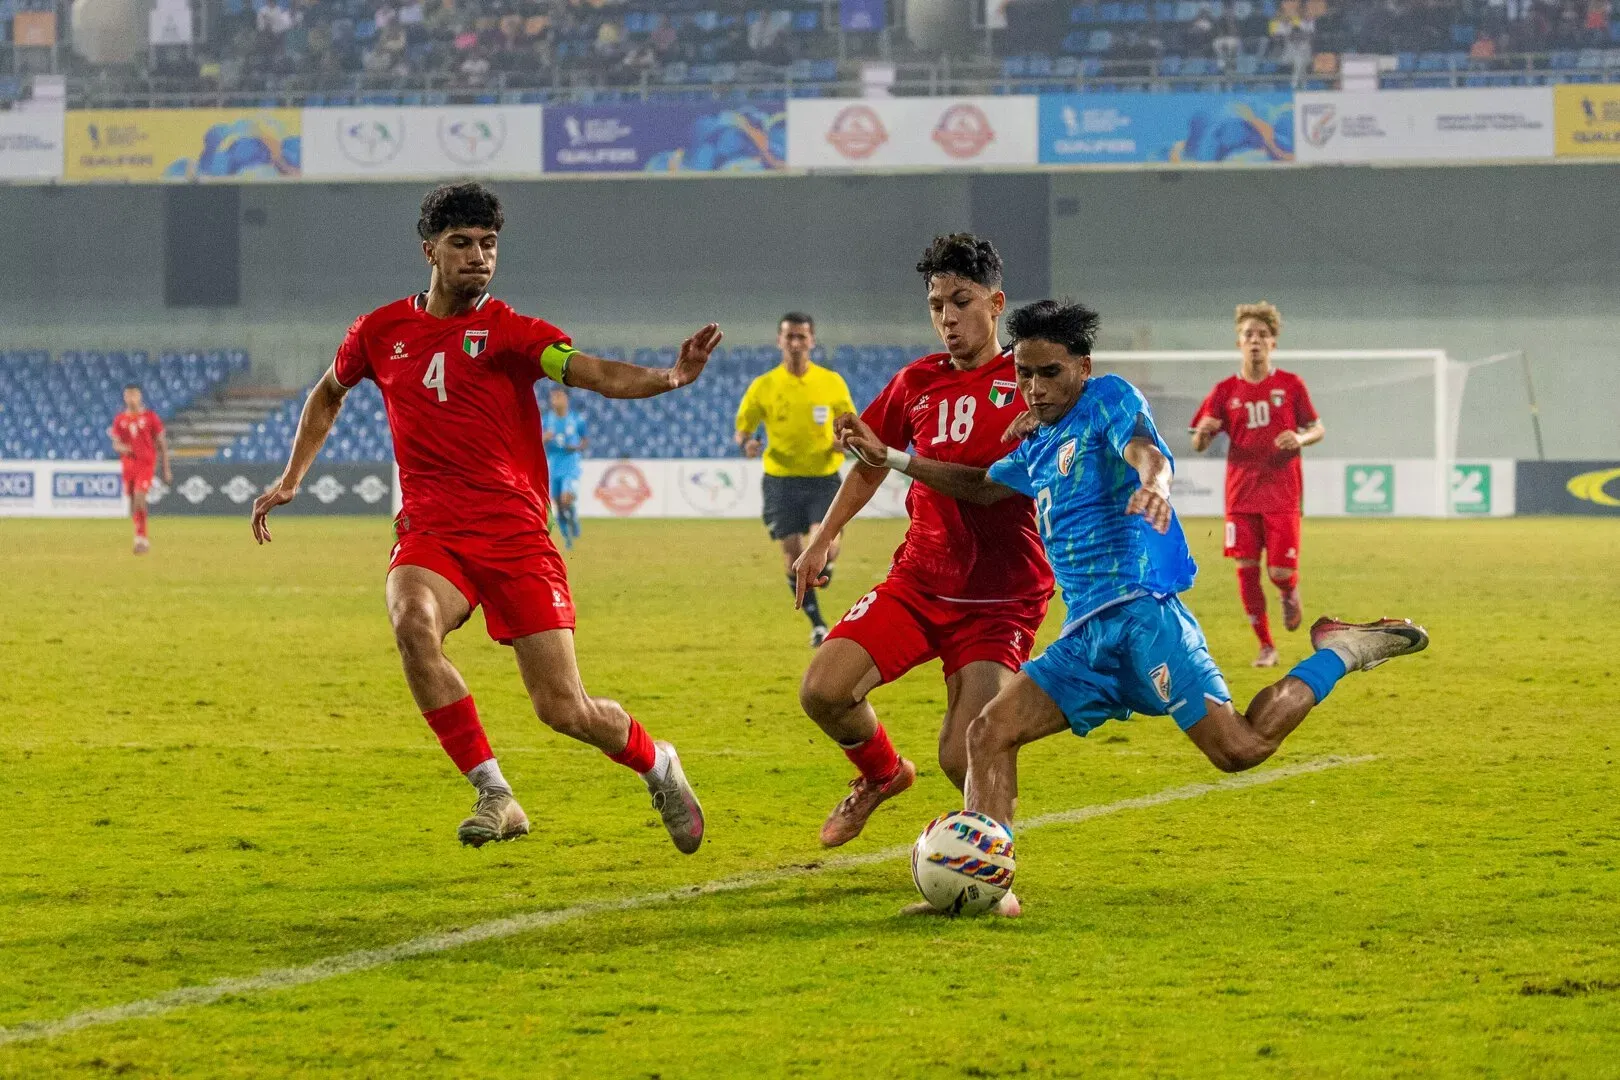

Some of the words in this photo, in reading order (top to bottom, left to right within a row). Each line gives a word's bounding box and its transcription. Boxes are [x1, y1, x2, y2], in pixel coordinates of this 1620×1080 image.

[422, 352, 448, 402] 4
[930, 394, 977, 446] 18
[1244, 400, 1270, 429] 10
[835, 590, 878, 626] 8
